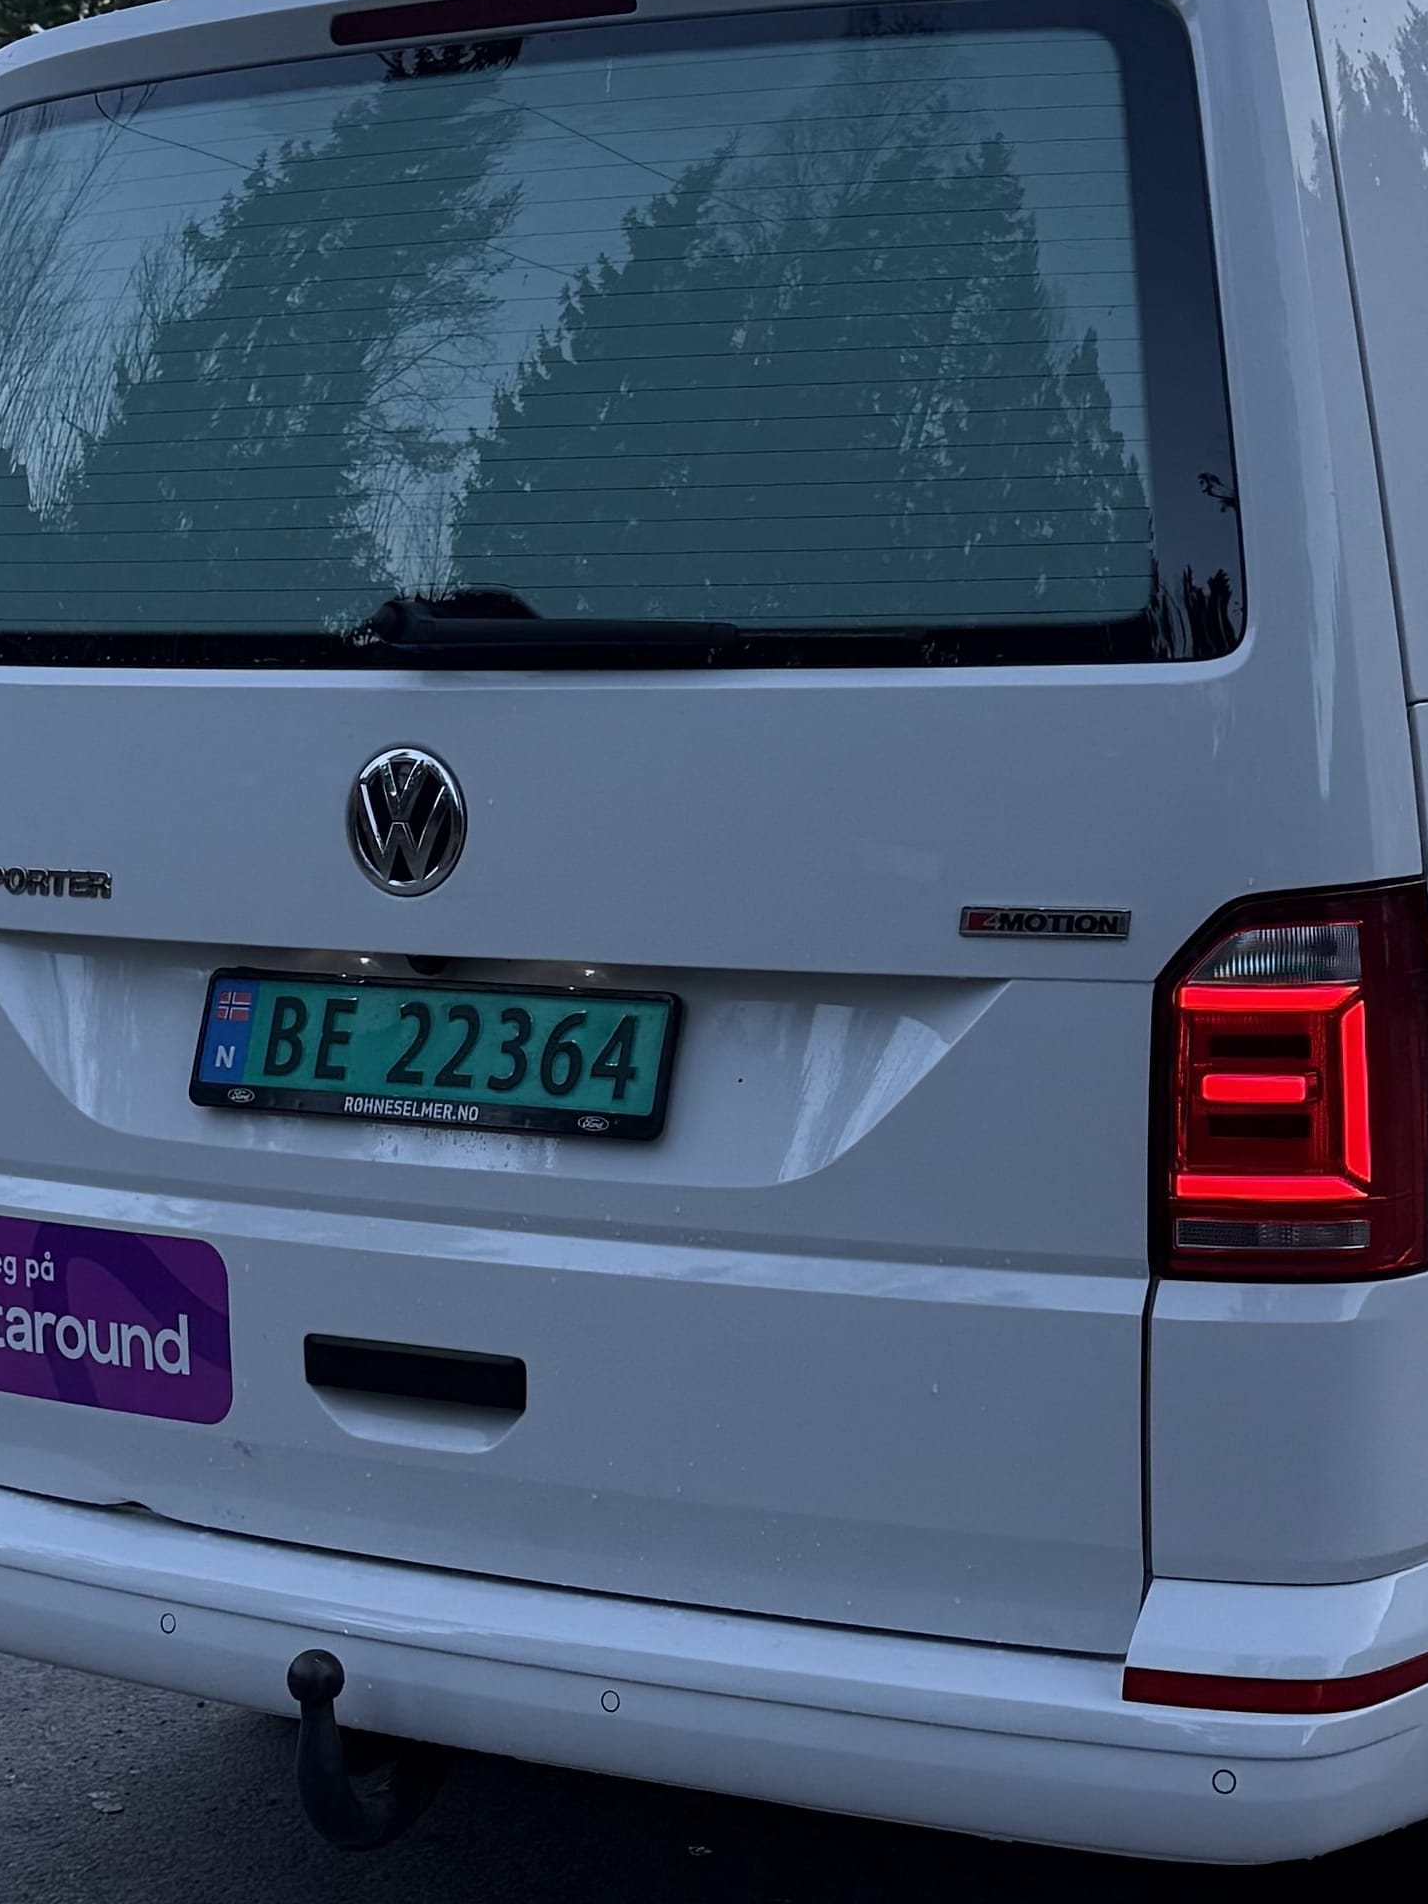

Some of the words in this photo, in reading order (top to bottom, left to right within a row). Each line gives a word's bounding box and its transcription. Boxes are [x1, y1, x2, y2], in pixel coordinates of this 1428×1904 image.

[982, 912, 1120, 934] 4MOTION
[215, 1045, 235, 1069] N
[263, 996, 358, 1081] BE
[386, 1001, 637, 1100] 22364
[342, 1094, 480, 1122] RØHNESELMER.NO
[25, 1251, 55, 1287] på
